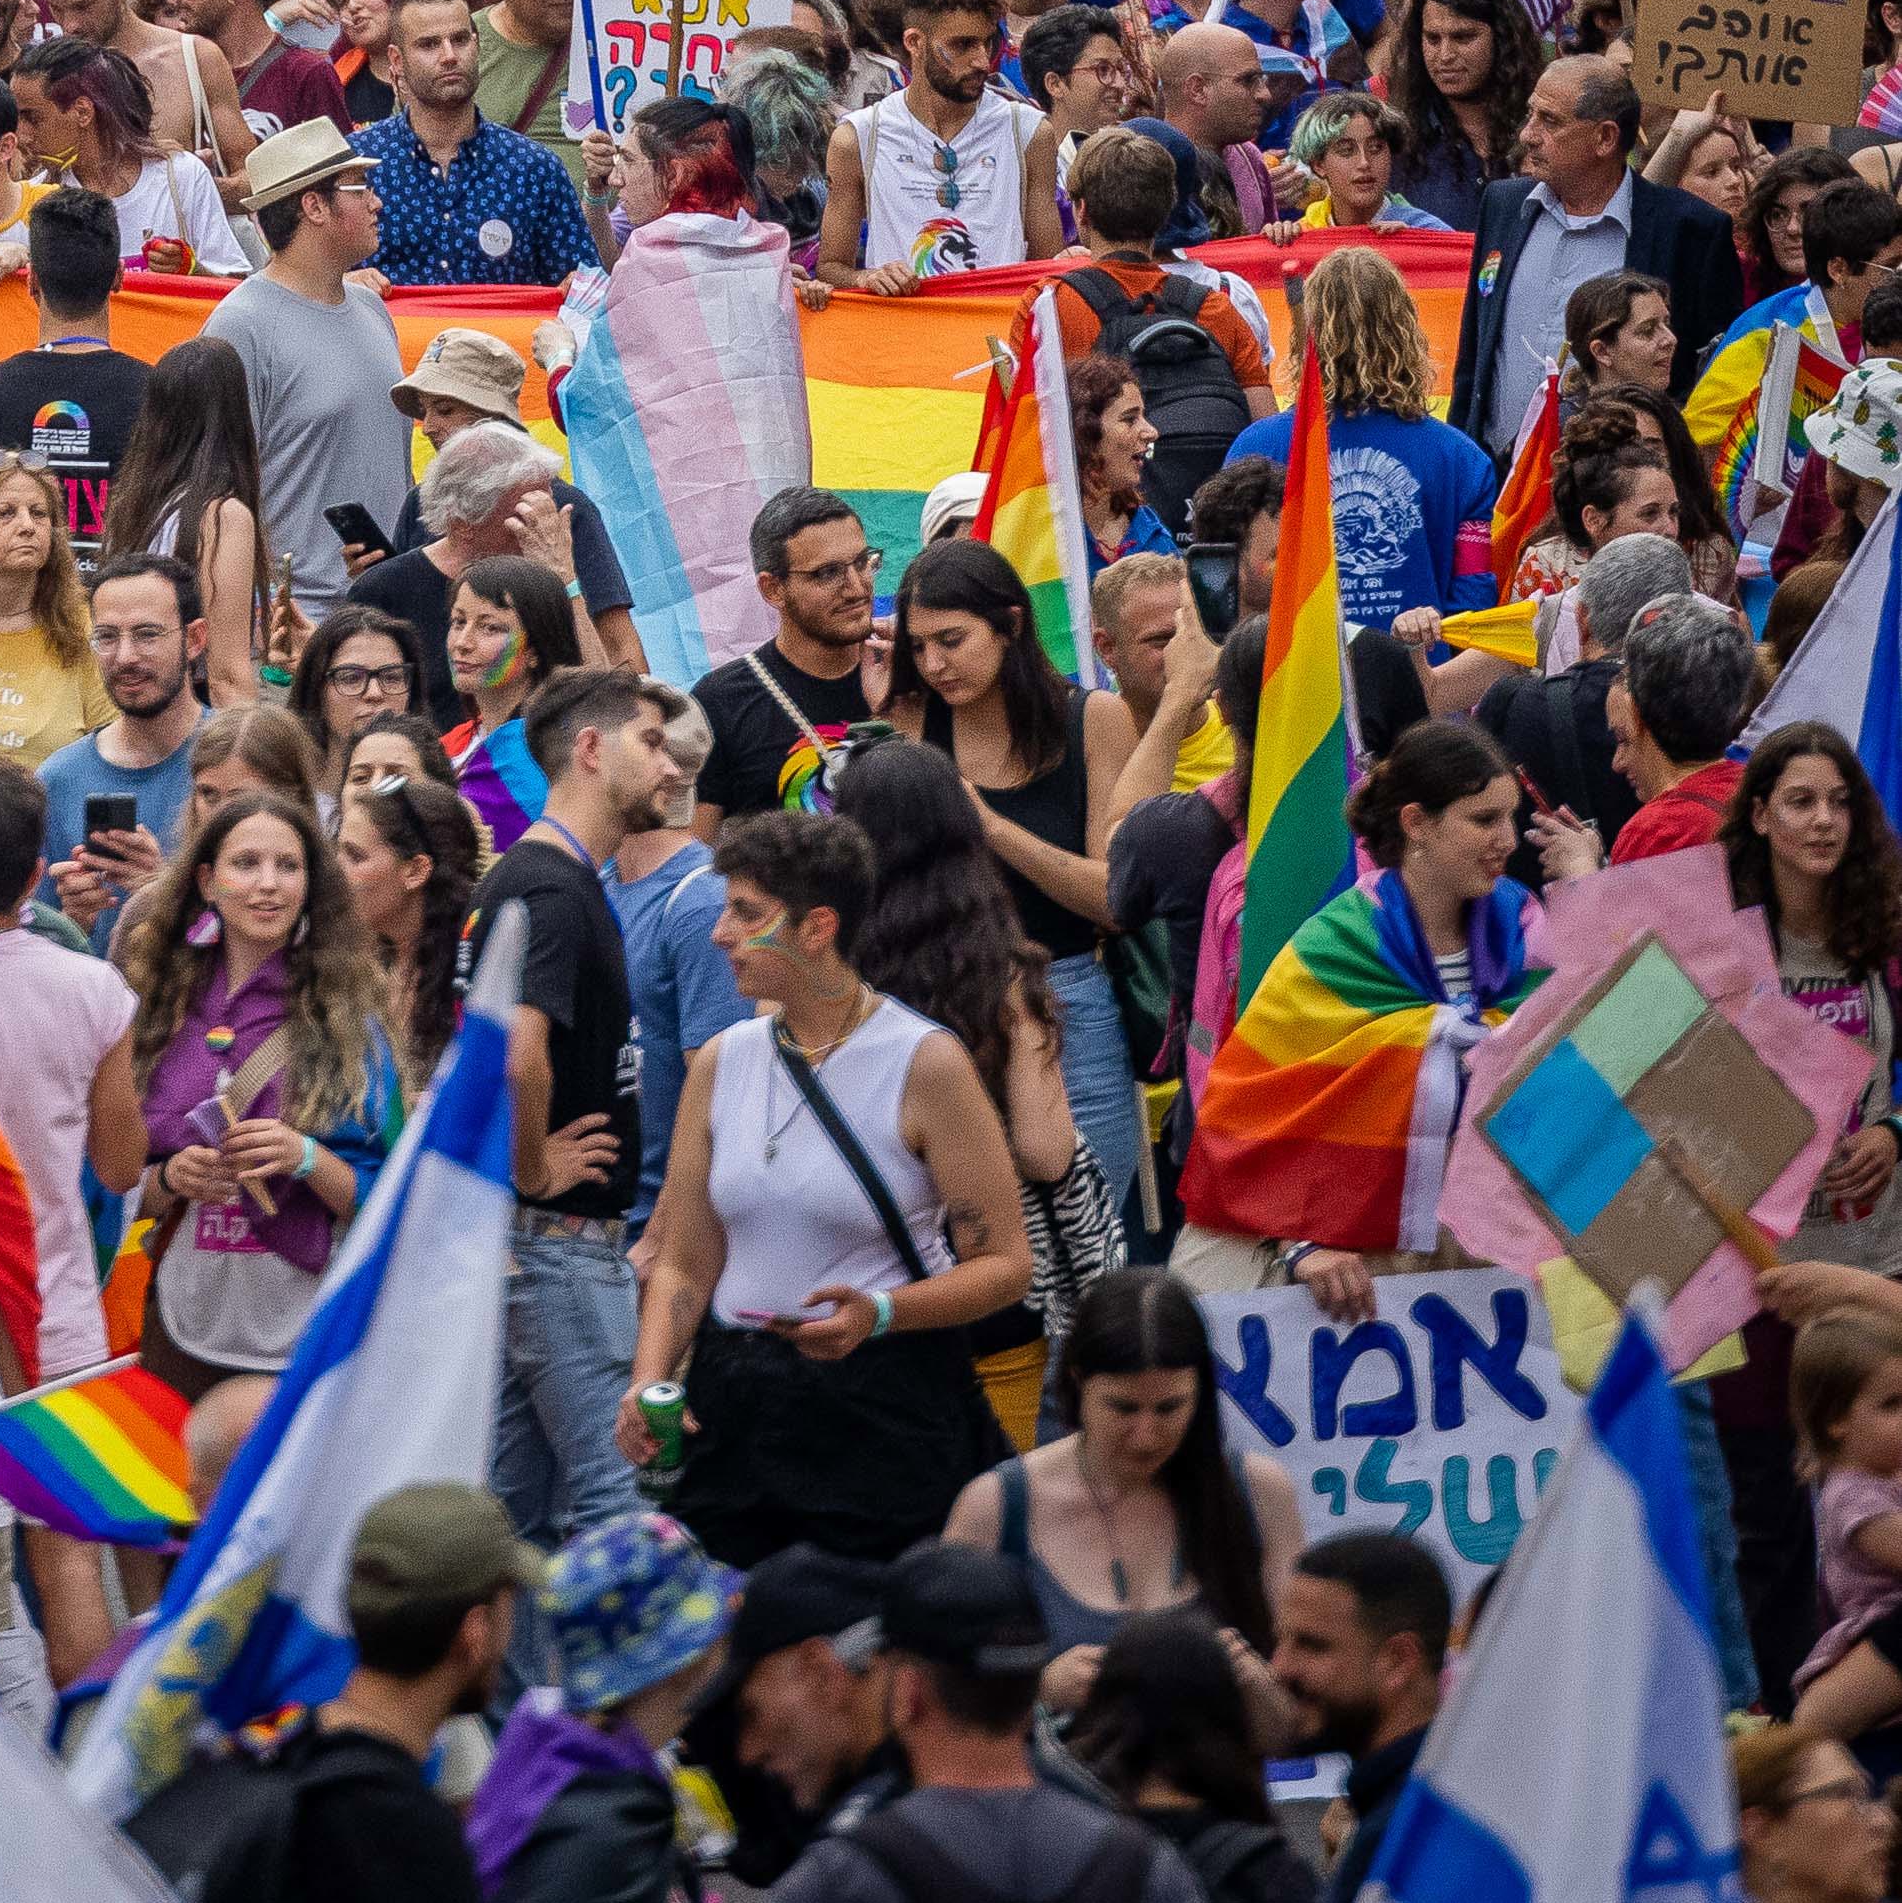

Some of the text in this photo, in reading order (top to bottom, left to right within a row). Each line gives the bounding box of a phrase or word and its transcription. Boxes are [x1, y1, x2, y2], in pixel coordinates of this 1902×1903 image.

[1678, 4, 1814, 46] אוהב
[1655, 39, 1808, 94] אותך!
[0, 688, 25, 707] To
[1213, 1289, 1548, 1447] אמא
